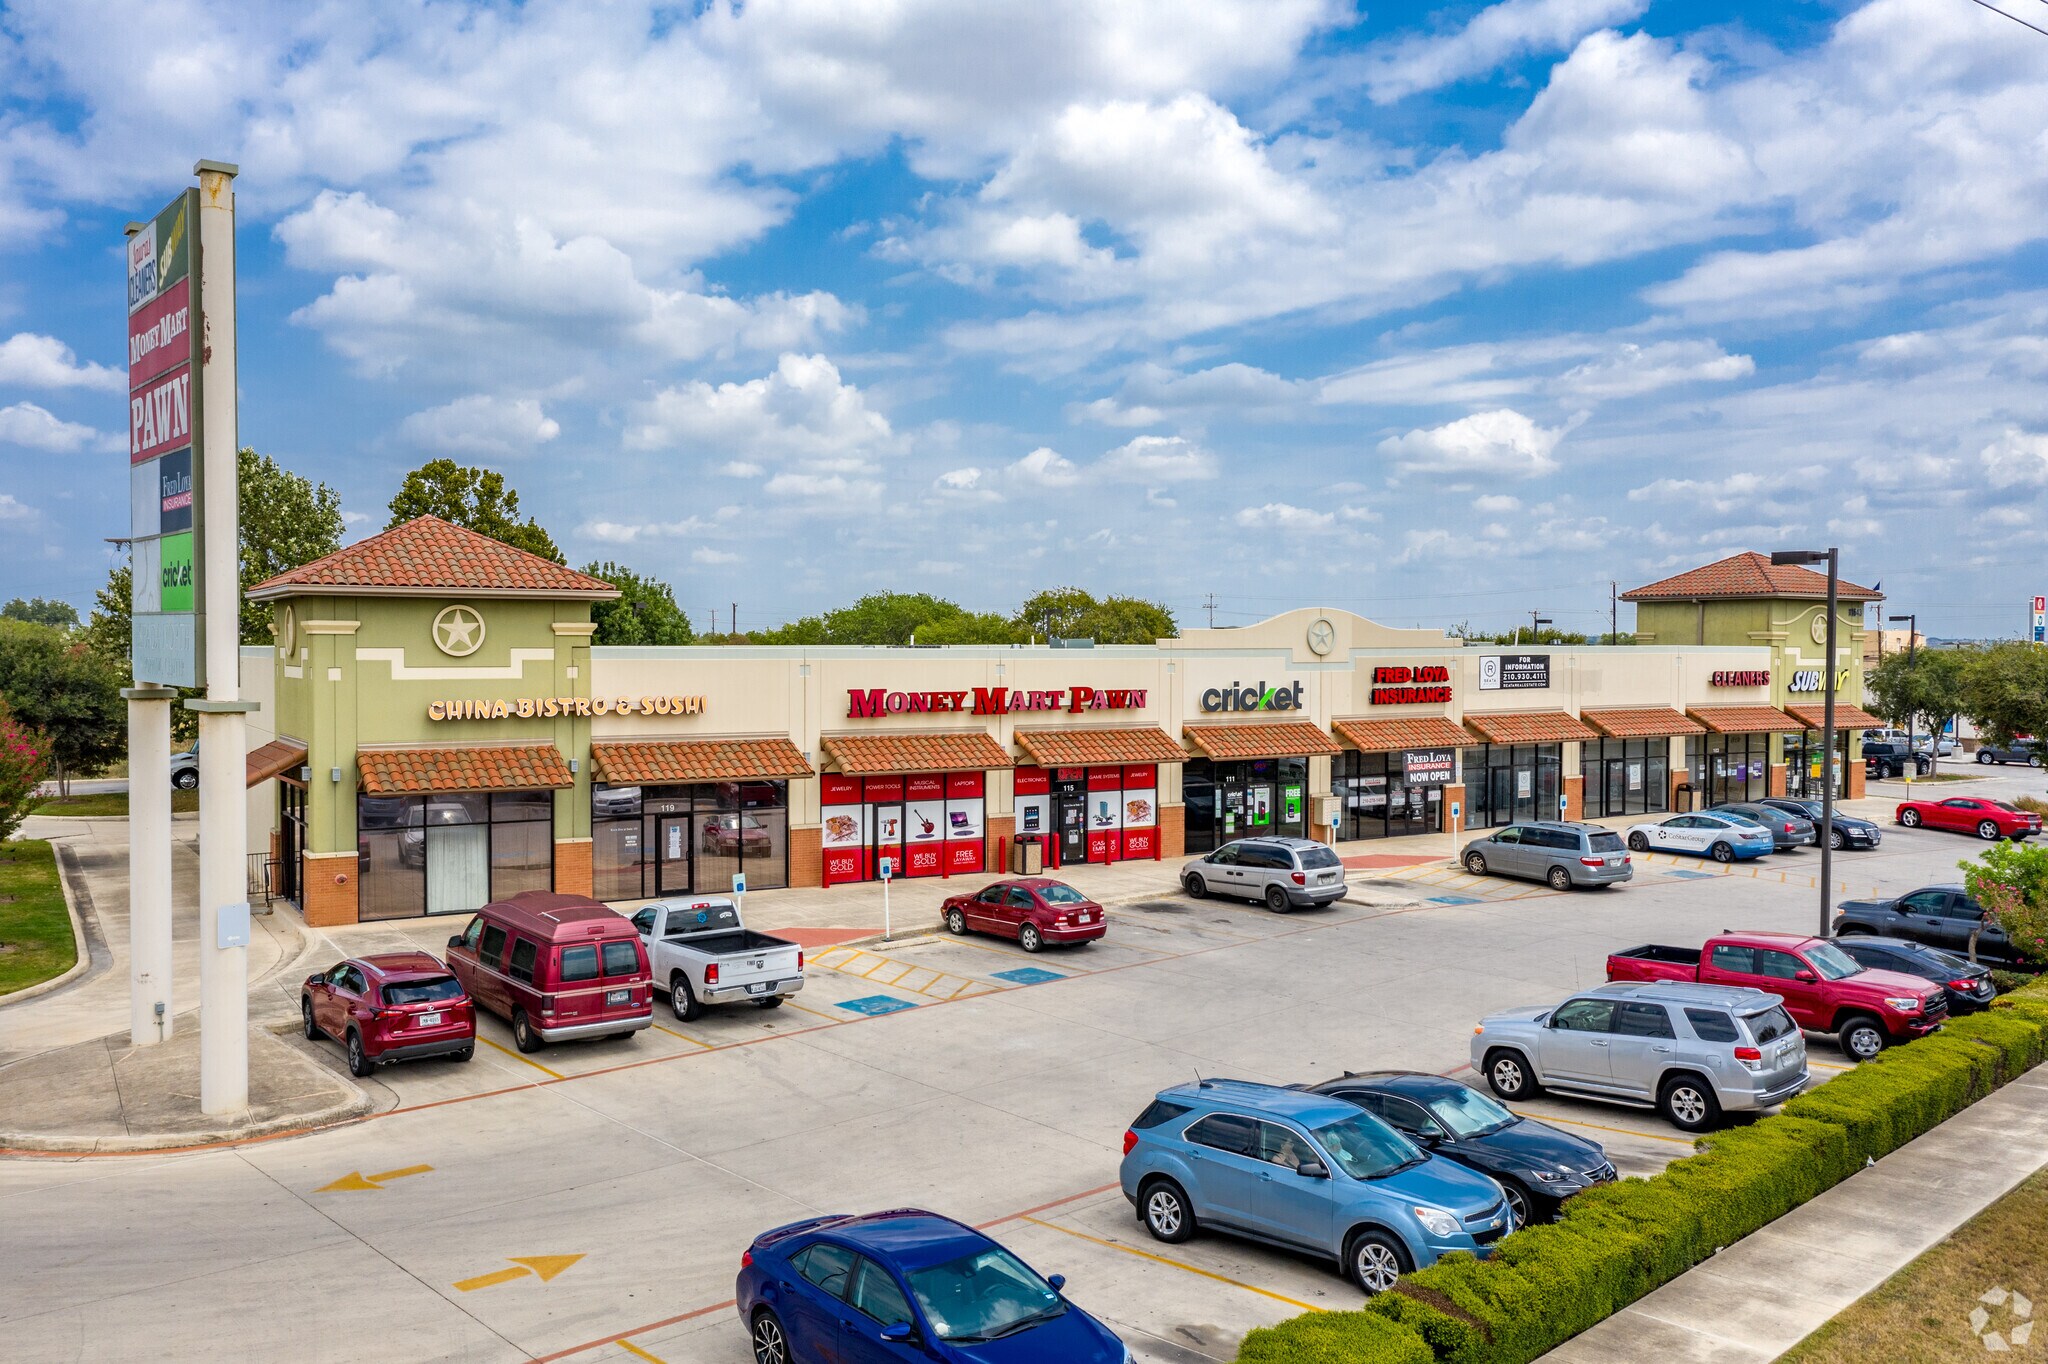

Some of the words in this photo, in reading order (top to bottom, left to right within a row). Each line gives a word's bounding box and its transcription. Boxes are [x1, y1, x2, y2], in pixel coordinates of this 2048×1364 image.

[159, 197, 187, 288] SUBWAY
[130, 259, 156, 307] CLEANERS
[132, 373, 188, 454] PAWN
[163, 493, 192, 510] INSURANCE
[162, 559, 192, 588] cricket
[1374, 666, 1412, 684] FRED
[1414, 666, 1450, 682] LOYA
[1713, 670, 1770, 686] CLEANERS
[1202, 680, 1304, 712] cricket
[1372, 686, 1452, 704] INSURANCE
[428, 699, 509, 721] CHINA
[516, 695, 609, 718] BISTRO
[615, 697, 634, 716] &
[640, 695, 709, 716] SUSHI
[1408, 762, 1450, 770] INSURANCE
[1410, 772, 1428, 782] NOW
[1430, 771, 1450, 780] OPEN
[1286, 788, 1300, 797] FREE
